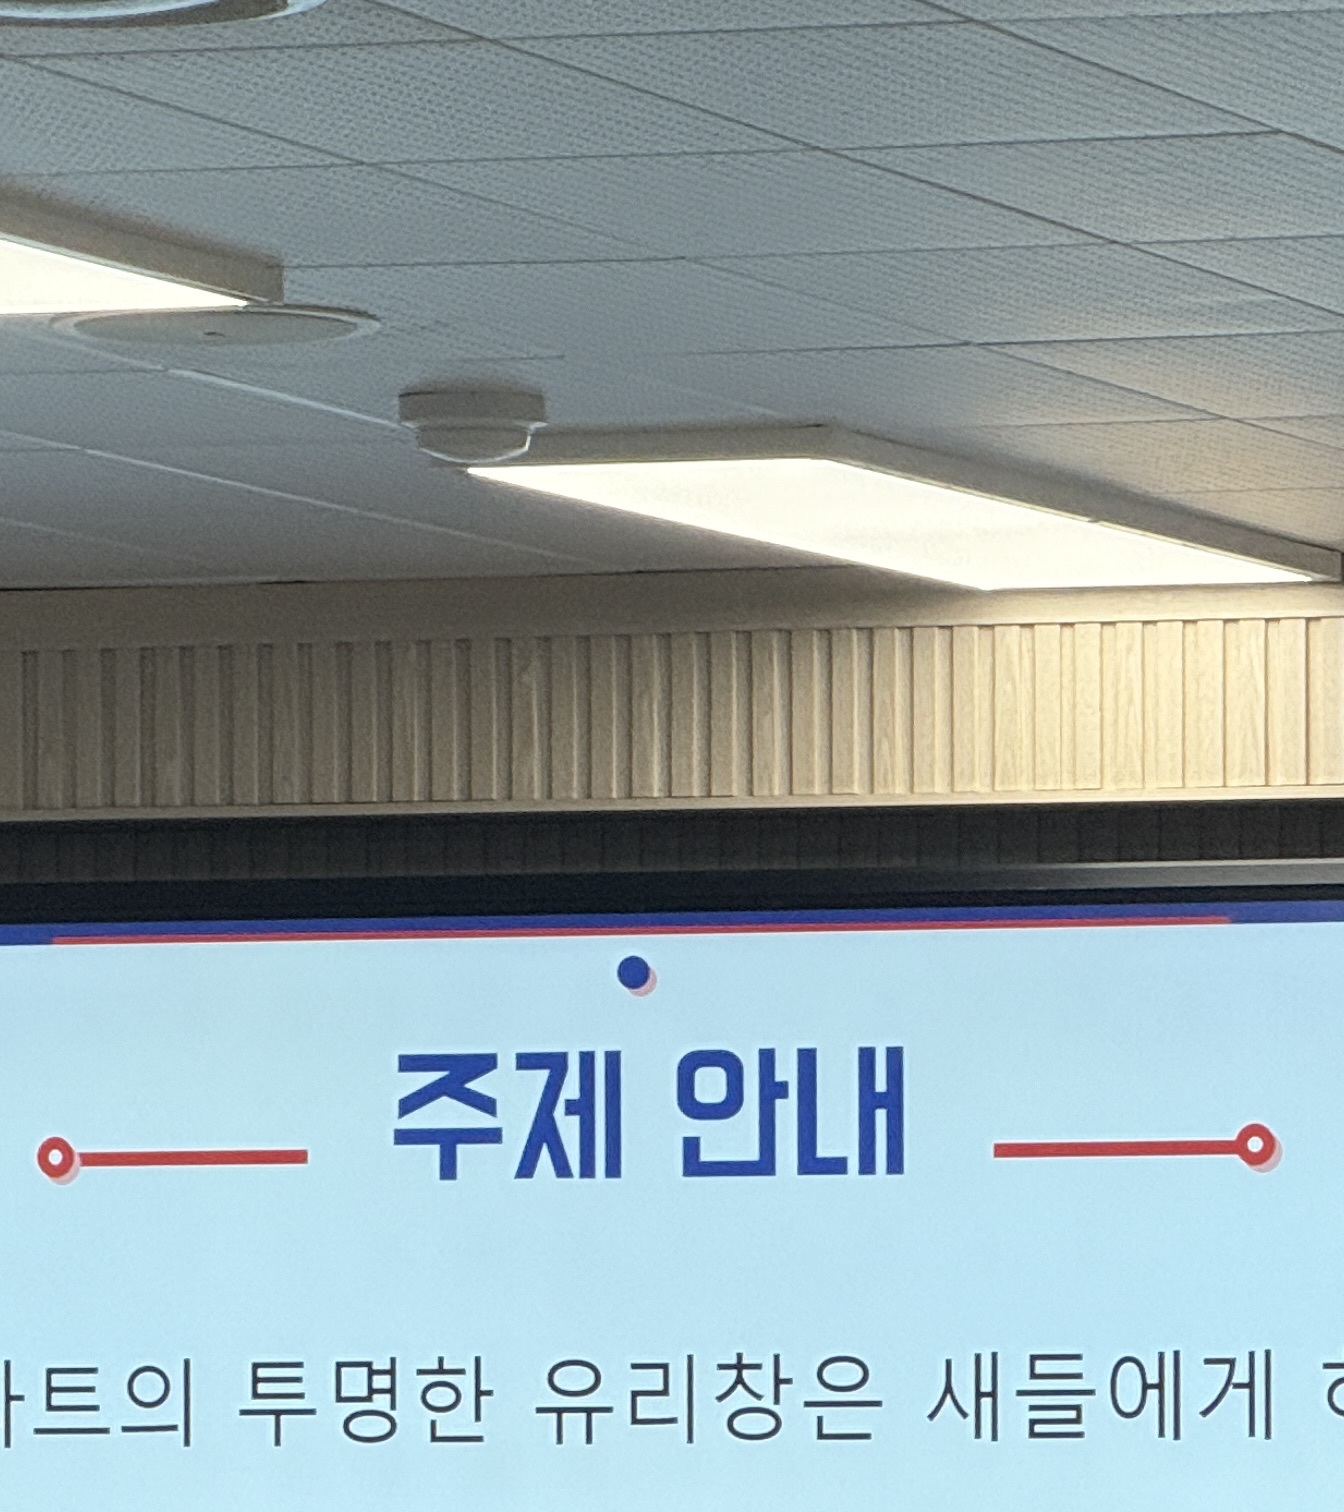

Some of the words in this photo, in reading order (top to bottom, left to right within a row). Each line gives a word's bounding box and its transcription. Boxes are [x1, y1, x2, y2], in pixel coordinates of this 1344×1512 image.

[394, 1050, 622, 1181] 주제
[676, 1046, 904, 1177] 안내
[239, 1355, 494, 1447] 투명한
[535, 1352, 883, 1445] 유리창은
[927, 1349, 1274, 1442] 새들에게
